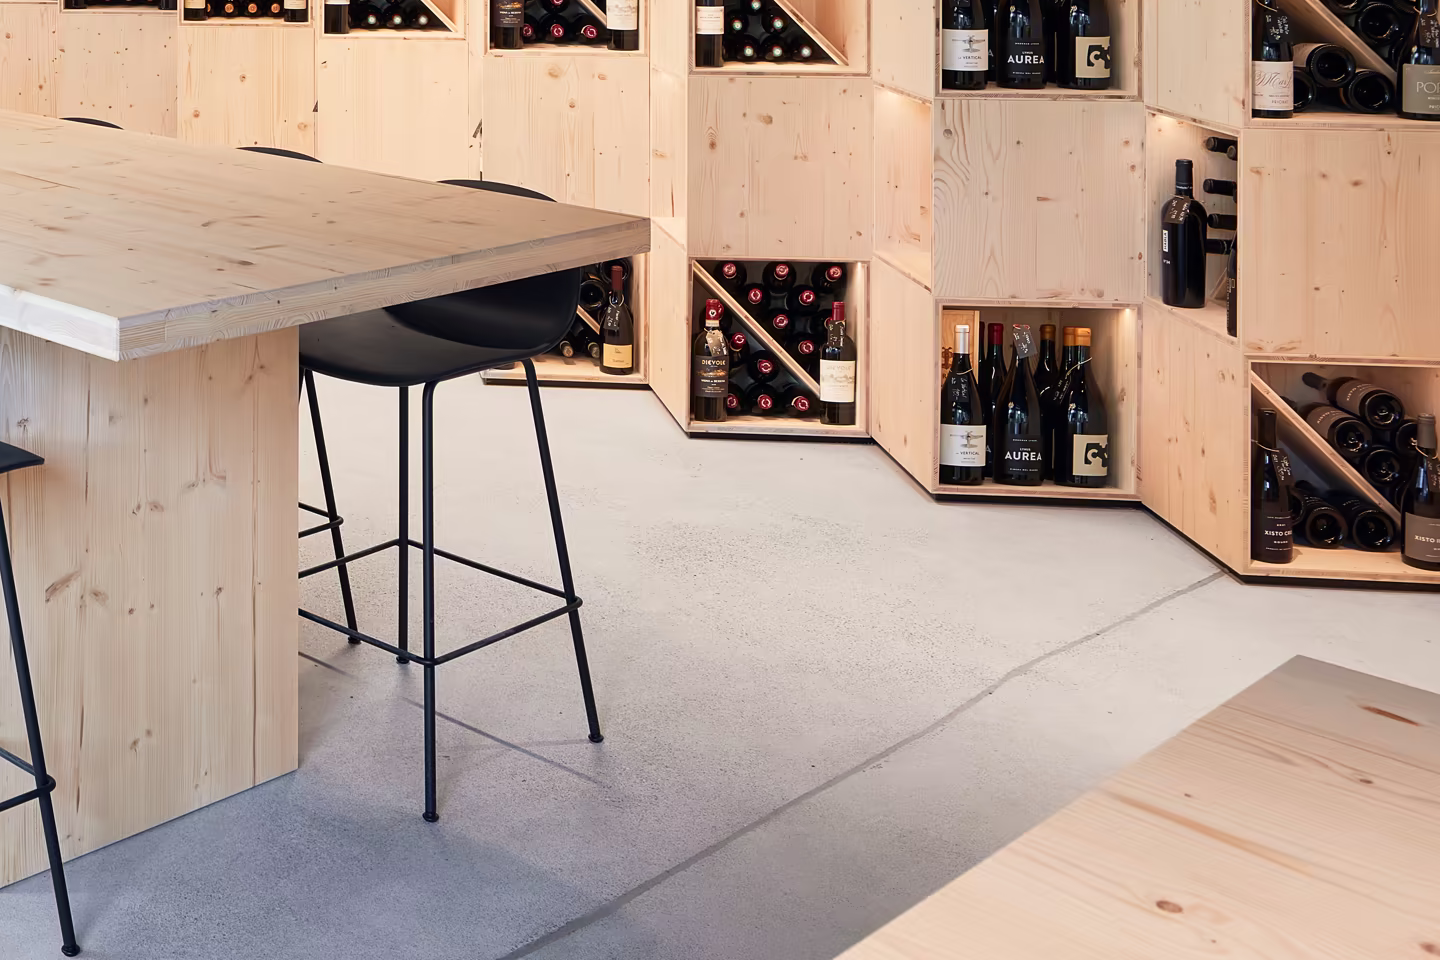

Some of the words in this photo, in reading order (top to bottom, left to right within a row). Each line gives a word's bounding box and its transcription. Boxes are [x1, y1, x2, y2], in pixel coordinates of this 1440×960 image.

[1007, 54, 1045, 64] AUREA
[1004, 451, 1042, 461] AUREA
[1414, 535, 1436, 544] XISTO
